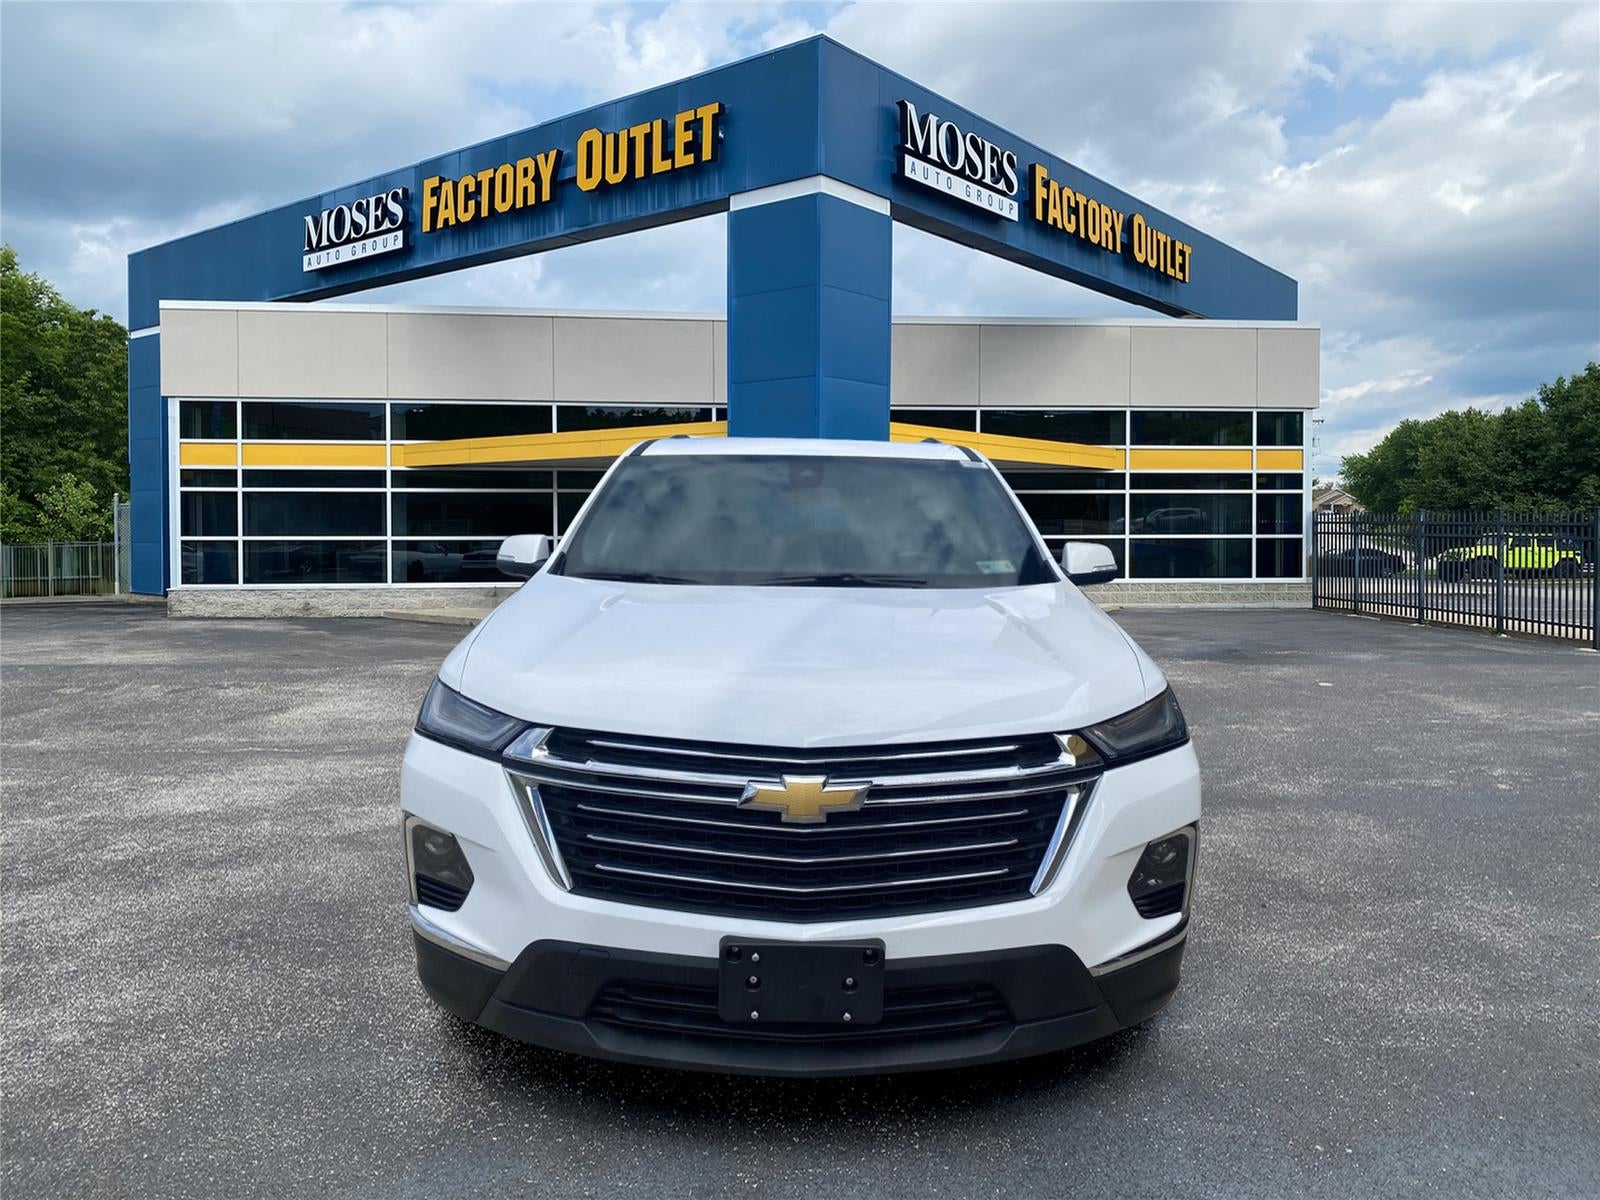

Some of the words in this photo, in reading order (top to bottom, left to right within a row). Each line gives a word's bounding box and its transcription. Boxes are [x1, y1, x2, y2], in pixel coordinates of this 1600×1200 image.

[421, 149, 559, 233] FACTORY
[576, 102, 721, 192] OUTLET
[904, 100, 1018, 196] MOSES
[910, 161, 953, 190] AUTO
[965, 184, 1014, 215] GROUP
[303, 187, 404, 251] MOSES
[307, 249, 340, 267] AUTO
[351, 234, 399, 257] GROUP
[1035, 163, 1124, 254] FACTORY
[1133, 213, 1192, 283] OUTLET
